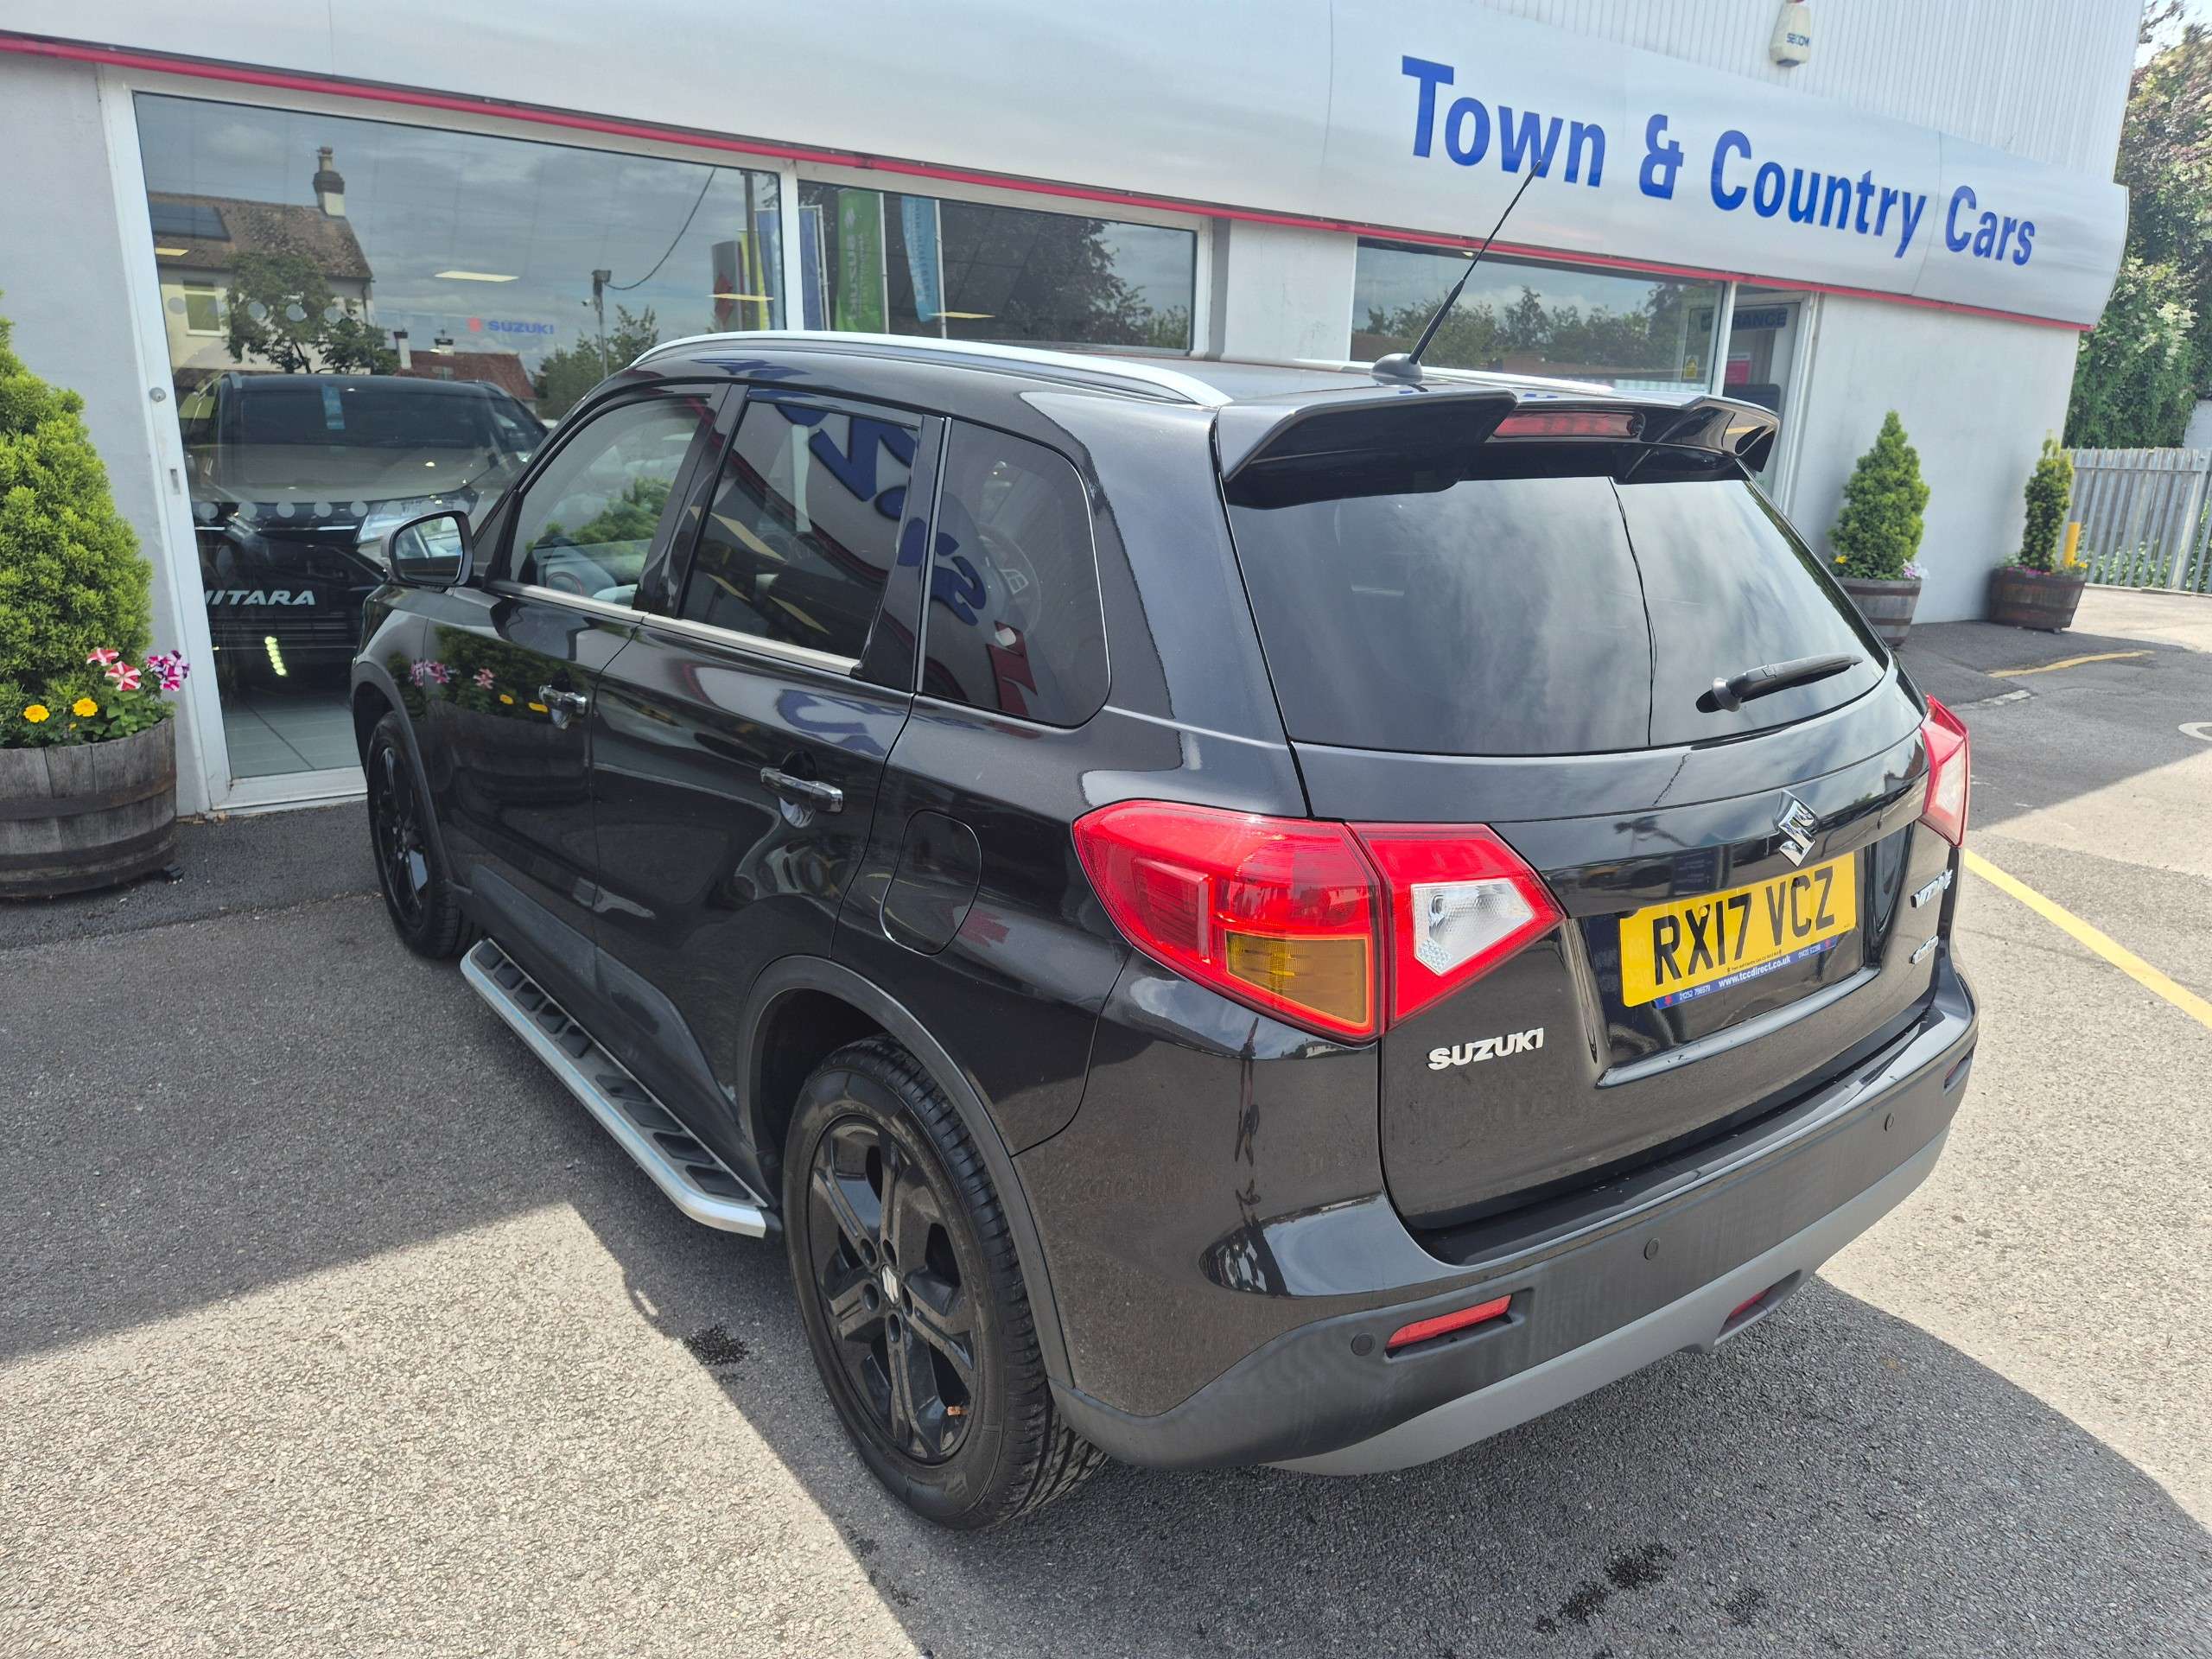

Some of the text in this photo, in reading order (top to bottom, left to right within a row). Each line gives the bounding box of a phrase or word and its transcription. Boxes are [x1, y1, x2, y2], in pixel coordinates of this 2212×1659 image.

[1402, 54, 2036, 266] Town & Country Cars
[488, 320, 555, 335] SUZUKI
[1652, 865, 1835, 986] RX17 VCZ
[1718, 954, 1791, 988] www.tccdirect.co.uk
[1427, 1027, 1544, 1071] SUZUKI
